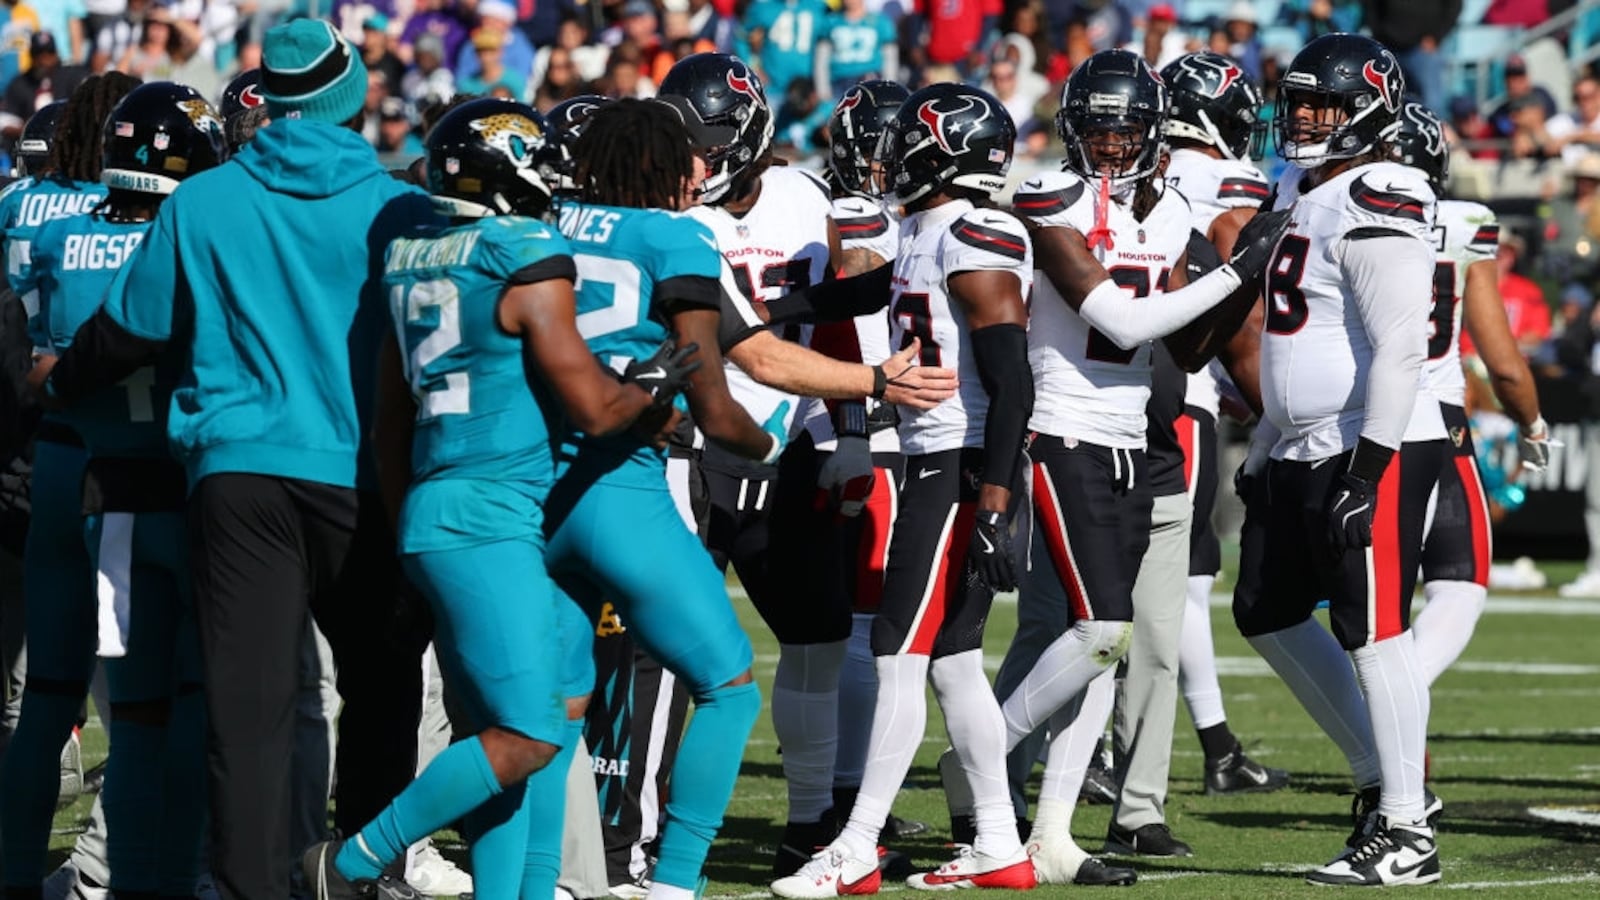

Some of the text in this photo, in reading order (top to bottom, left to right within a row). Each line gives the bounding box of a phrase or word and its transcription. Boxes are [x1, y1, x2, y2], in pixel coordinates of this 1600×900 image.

[134, 143, 149, 166] 4
[15, 193, 101, 227] JOHNS
[63, 232, 144, 270] BIGSB
[725, 247, 785, 259] OUSTON
[1117, 251, 1167, 263] HOUSTON
[390, 278, 471, 420] 12
